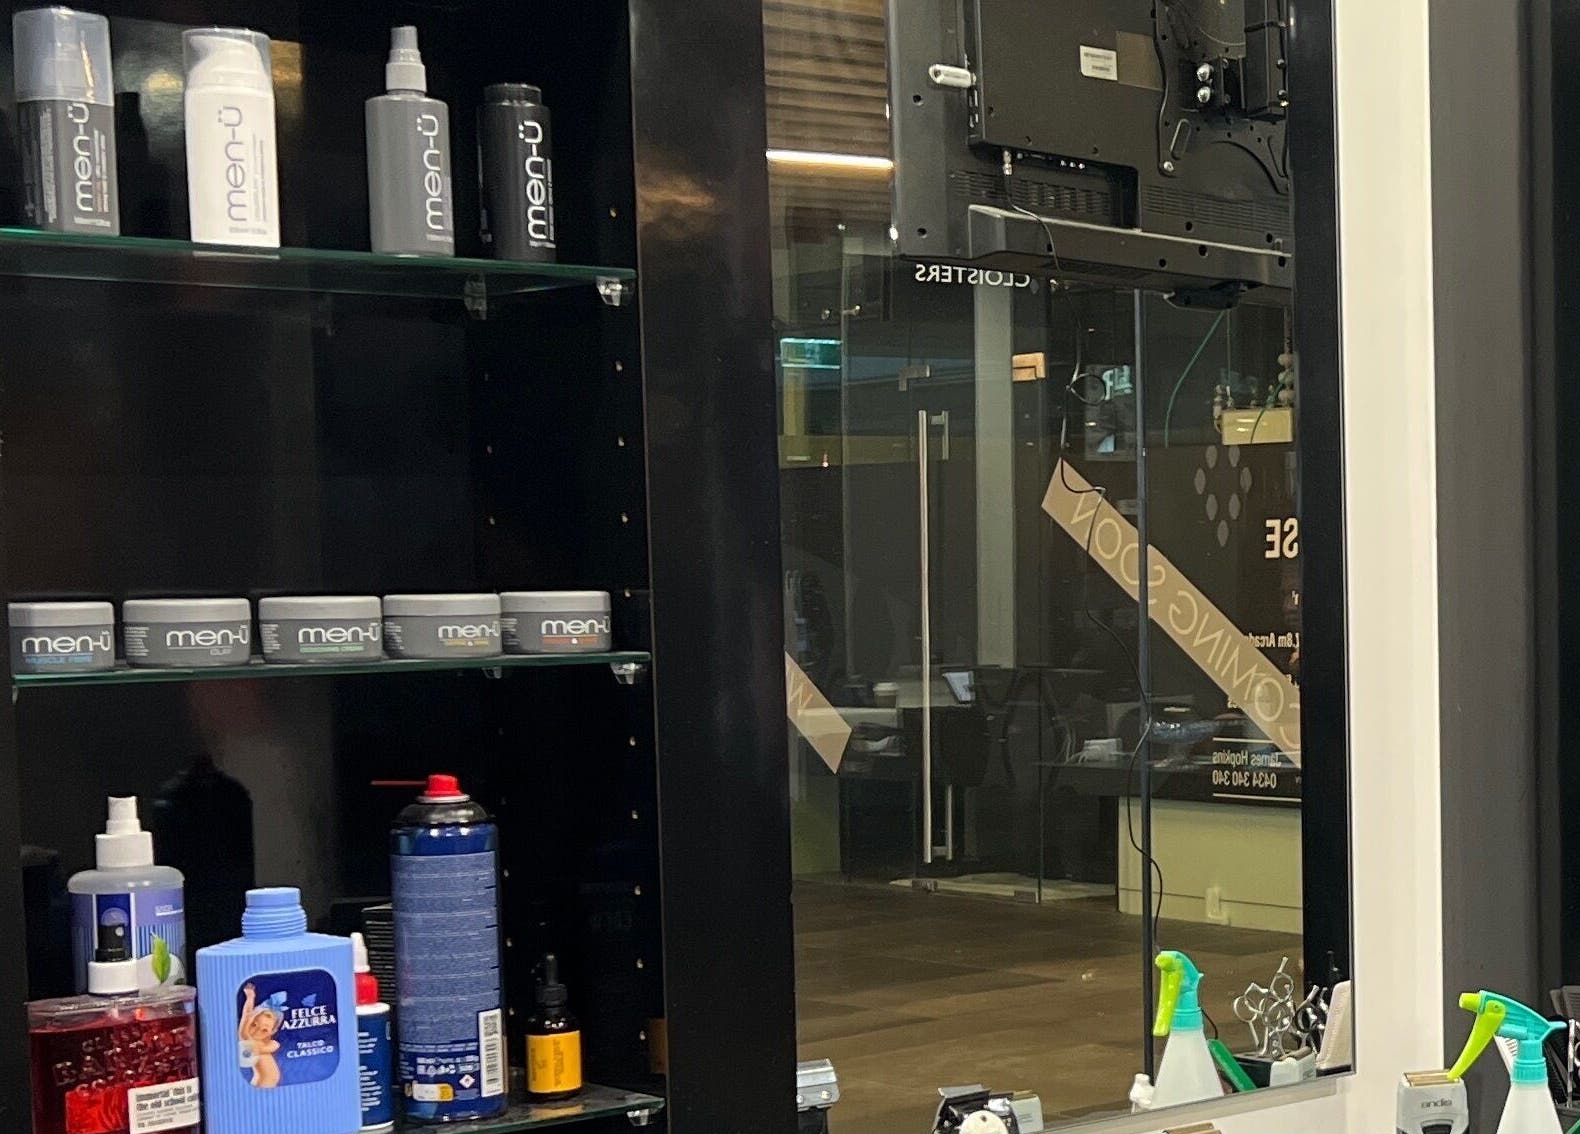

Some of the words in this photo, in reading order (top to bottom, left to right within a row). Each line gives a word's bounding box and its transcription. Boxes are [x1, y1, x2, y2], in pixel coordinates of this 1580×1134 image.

[291, 1005, 327, 1019] FELCE
[281, 1014, 337, 1031] AZZURRA
[296, 1039, 326, 1049] TALCO
[286, 1045, 335, 1058] CLASSICO
